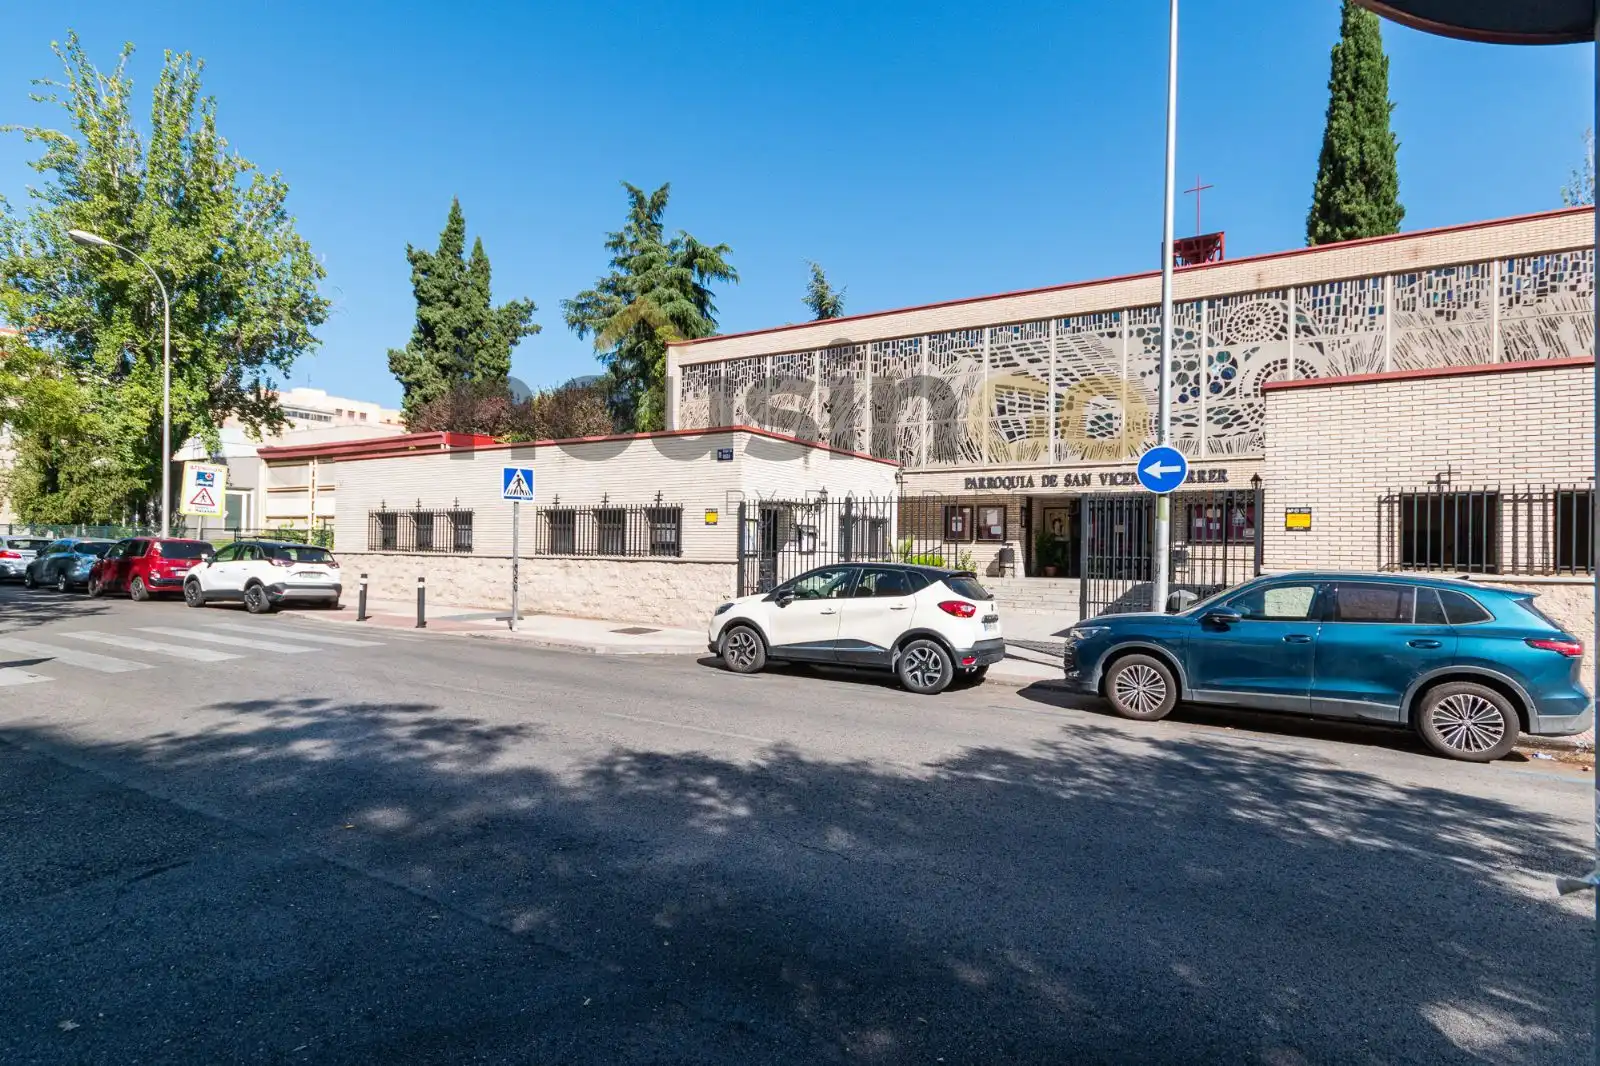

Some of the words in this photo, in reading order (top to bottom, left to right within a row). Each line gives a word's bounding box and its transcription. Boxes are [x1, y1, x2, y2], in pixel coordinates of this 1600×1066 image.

[964, 475, 1035, 491] PARROQUIA
[1041, 474, 1058, 487] DE
[1063, 473, 1092, 487] SAN
[1098, 471, 1140, 486] VICEN
[1185, 468, 1229, 484] RRER
